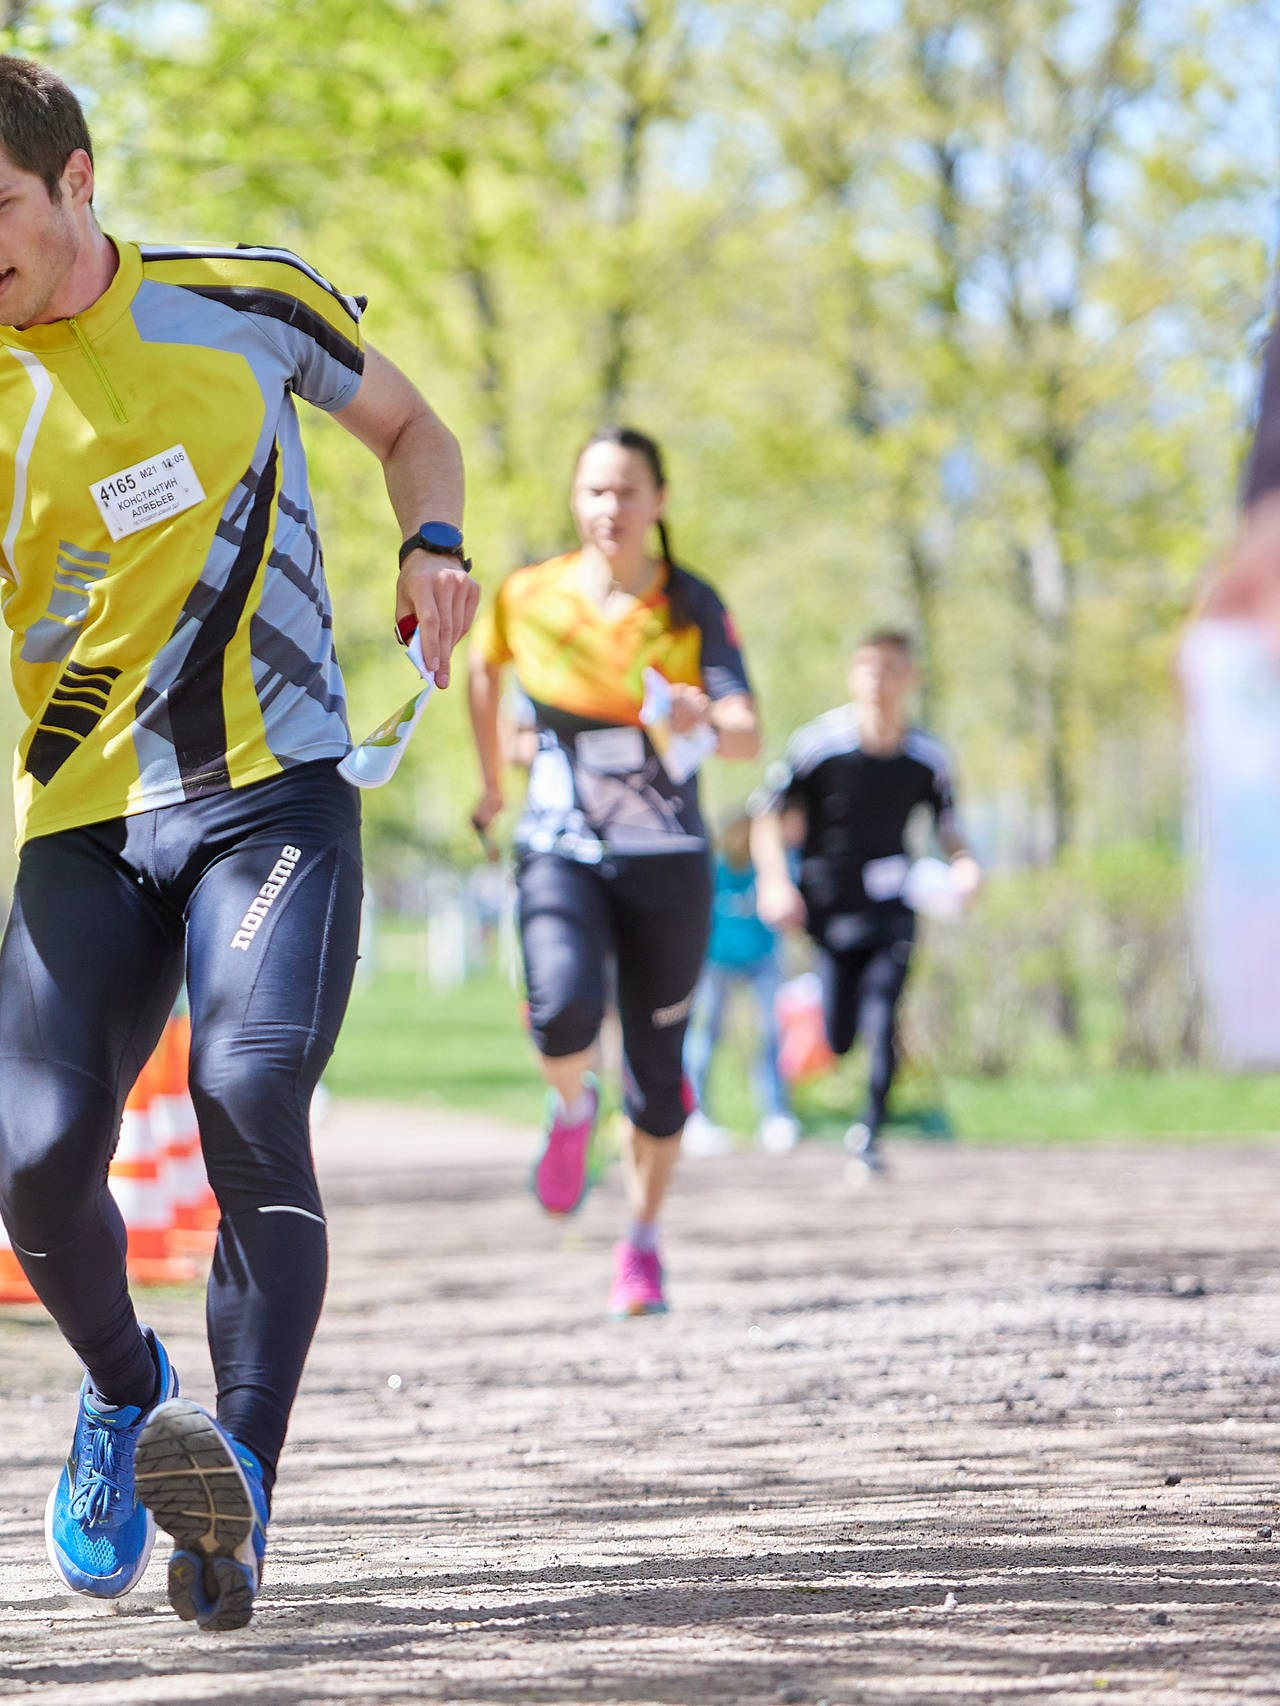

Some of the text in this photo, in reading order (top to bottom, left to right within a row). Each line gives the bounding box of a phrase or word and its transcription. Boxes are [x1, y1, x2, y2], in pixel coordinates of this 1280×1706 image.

[100, 474, 136, 501] 4165
[118, 477, 178, 511] КОНСТАНТИН
[131, 492, 175, 518] АЛЯБЬЕВ
[230, 844, 302, 951] noname
